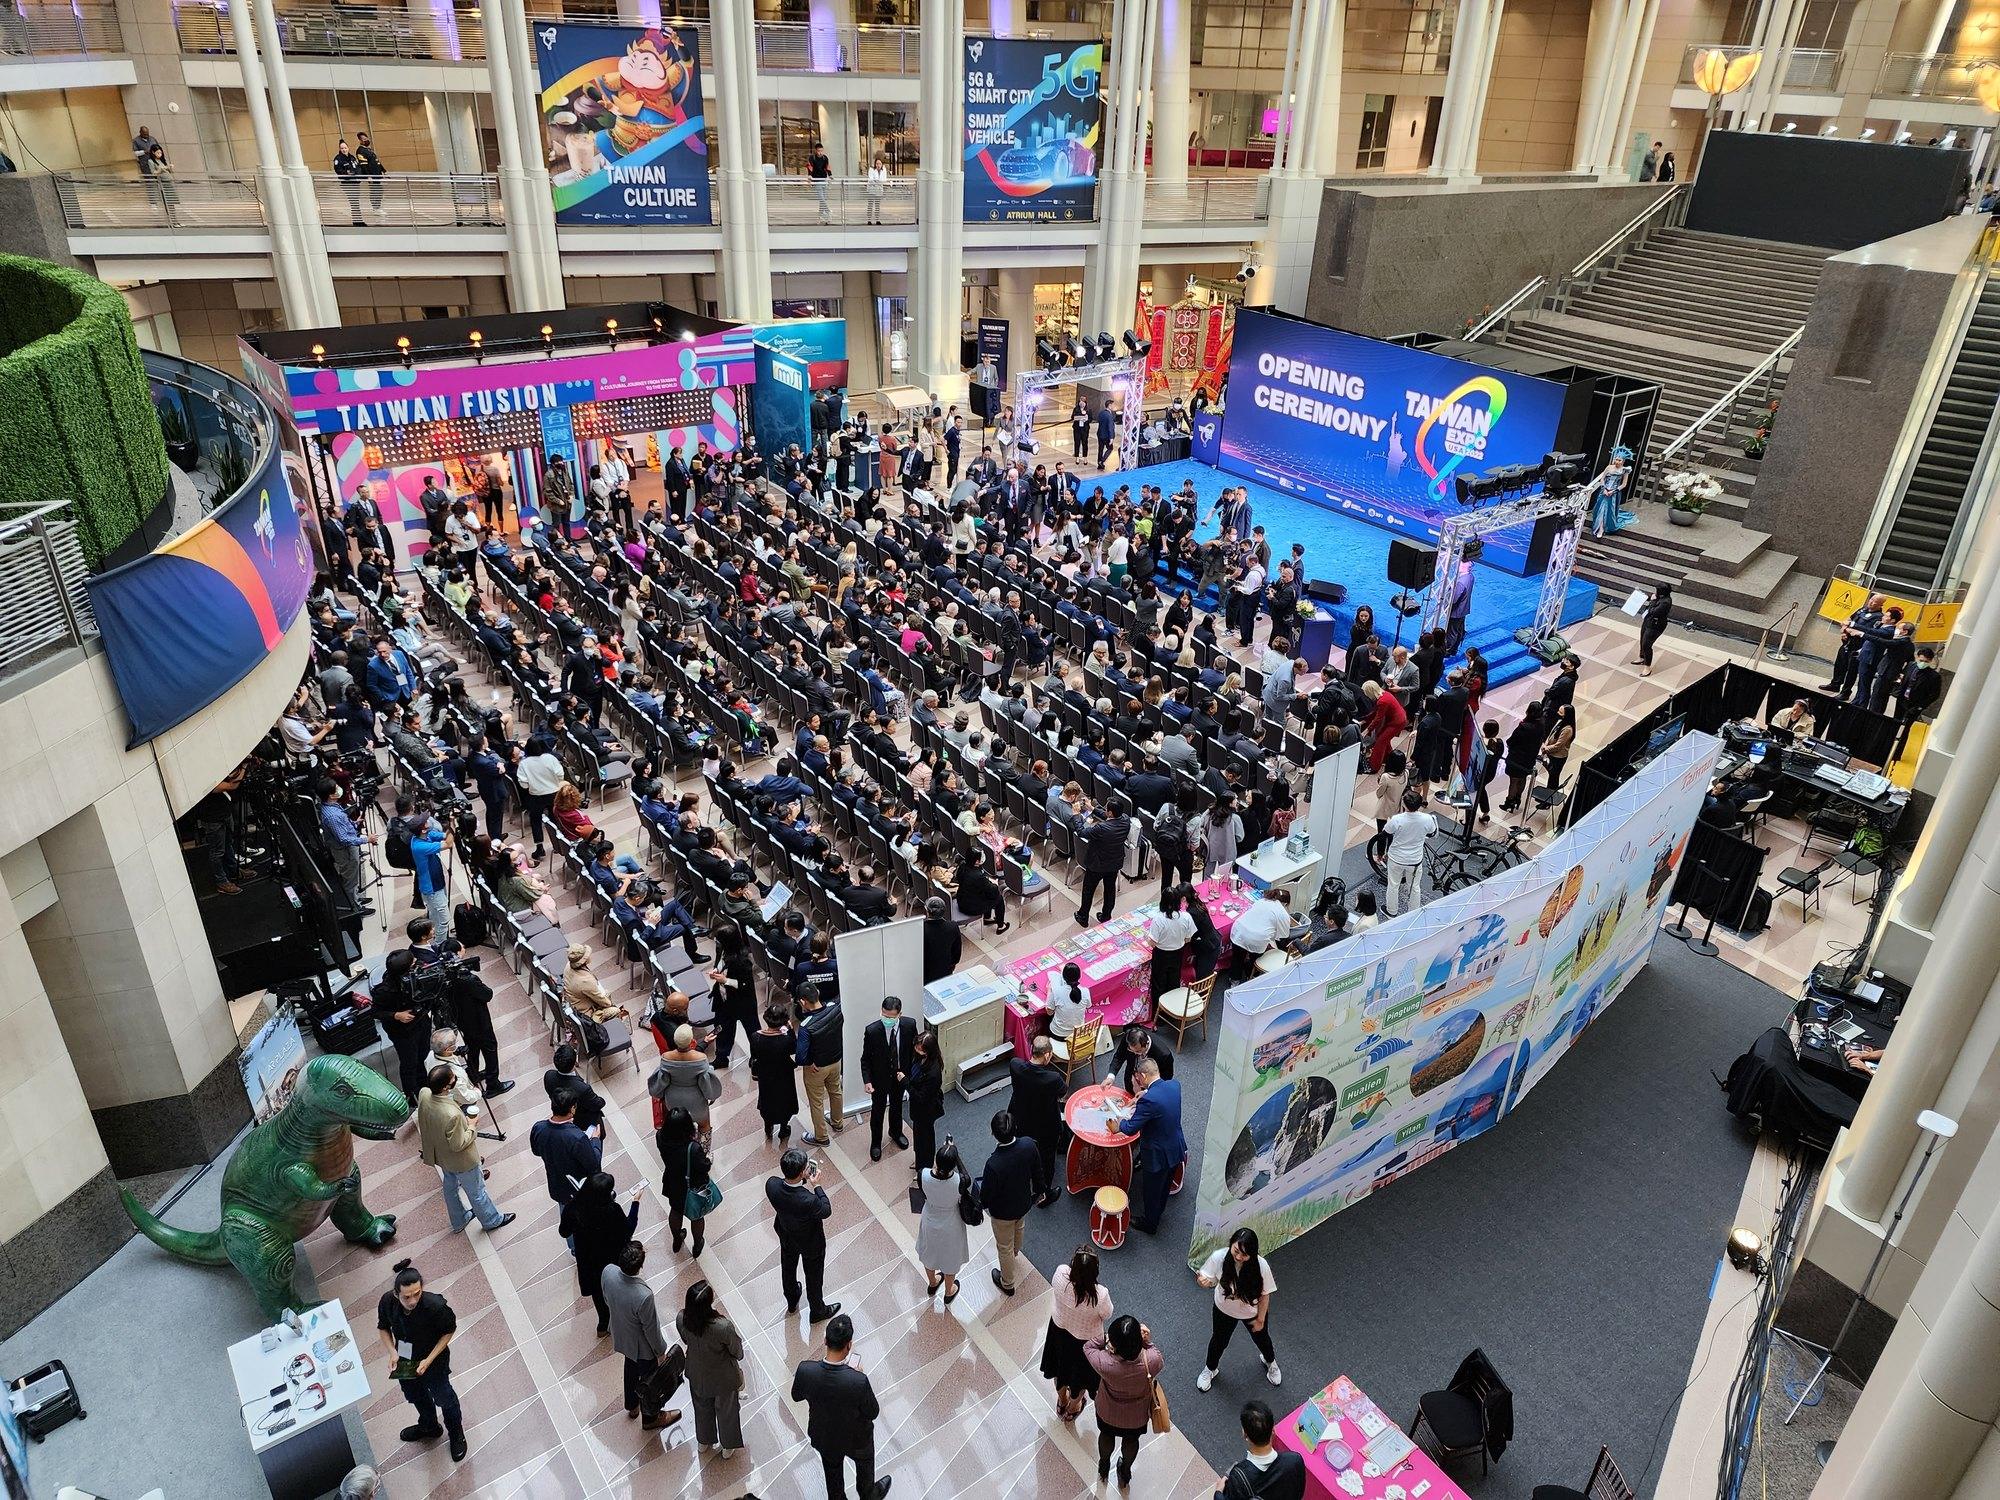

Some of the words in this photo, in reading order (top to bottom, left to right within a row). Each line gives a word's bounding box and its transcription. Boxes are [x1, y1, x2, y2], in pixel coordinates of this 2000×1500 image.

[968, 72, 984, 88] 5G
[986, 73, 995, 88] &
[1041, 44, 1097, 99] 5G
[968, 88, 1007, 104] SMART
[1009, 89, 1035, 104] CITY
[968, 114, 1007, 129] SMART
[968, 130, 1016, 145] VEHICLE
[606, 165, 667, 185] TAIWAN
[624, 188, 698, 207] CULTURE
[1006, 211, 1035, 220] ATRIUM
[1037, 211, 1057, 220] HALL
[1258, 353, 1365, 401] OPENING
[336, 394, 449, 432] TAIWAN
[461, 382, 558, 418] FUSION
[1254, 385, 1388, 442] CEREMONY
[1405, 390, 1493, 437] TAIWAN
[1445, 427, 1487, 451] EXPO
[1328, 975, 1362, 994] Kaohsiung
[1386, 1000, 1420, 1021] Pingtung
[1347, 1078, 1382, 1100] Hualien
[1402, 1123, 1421, 1138] Yilan
